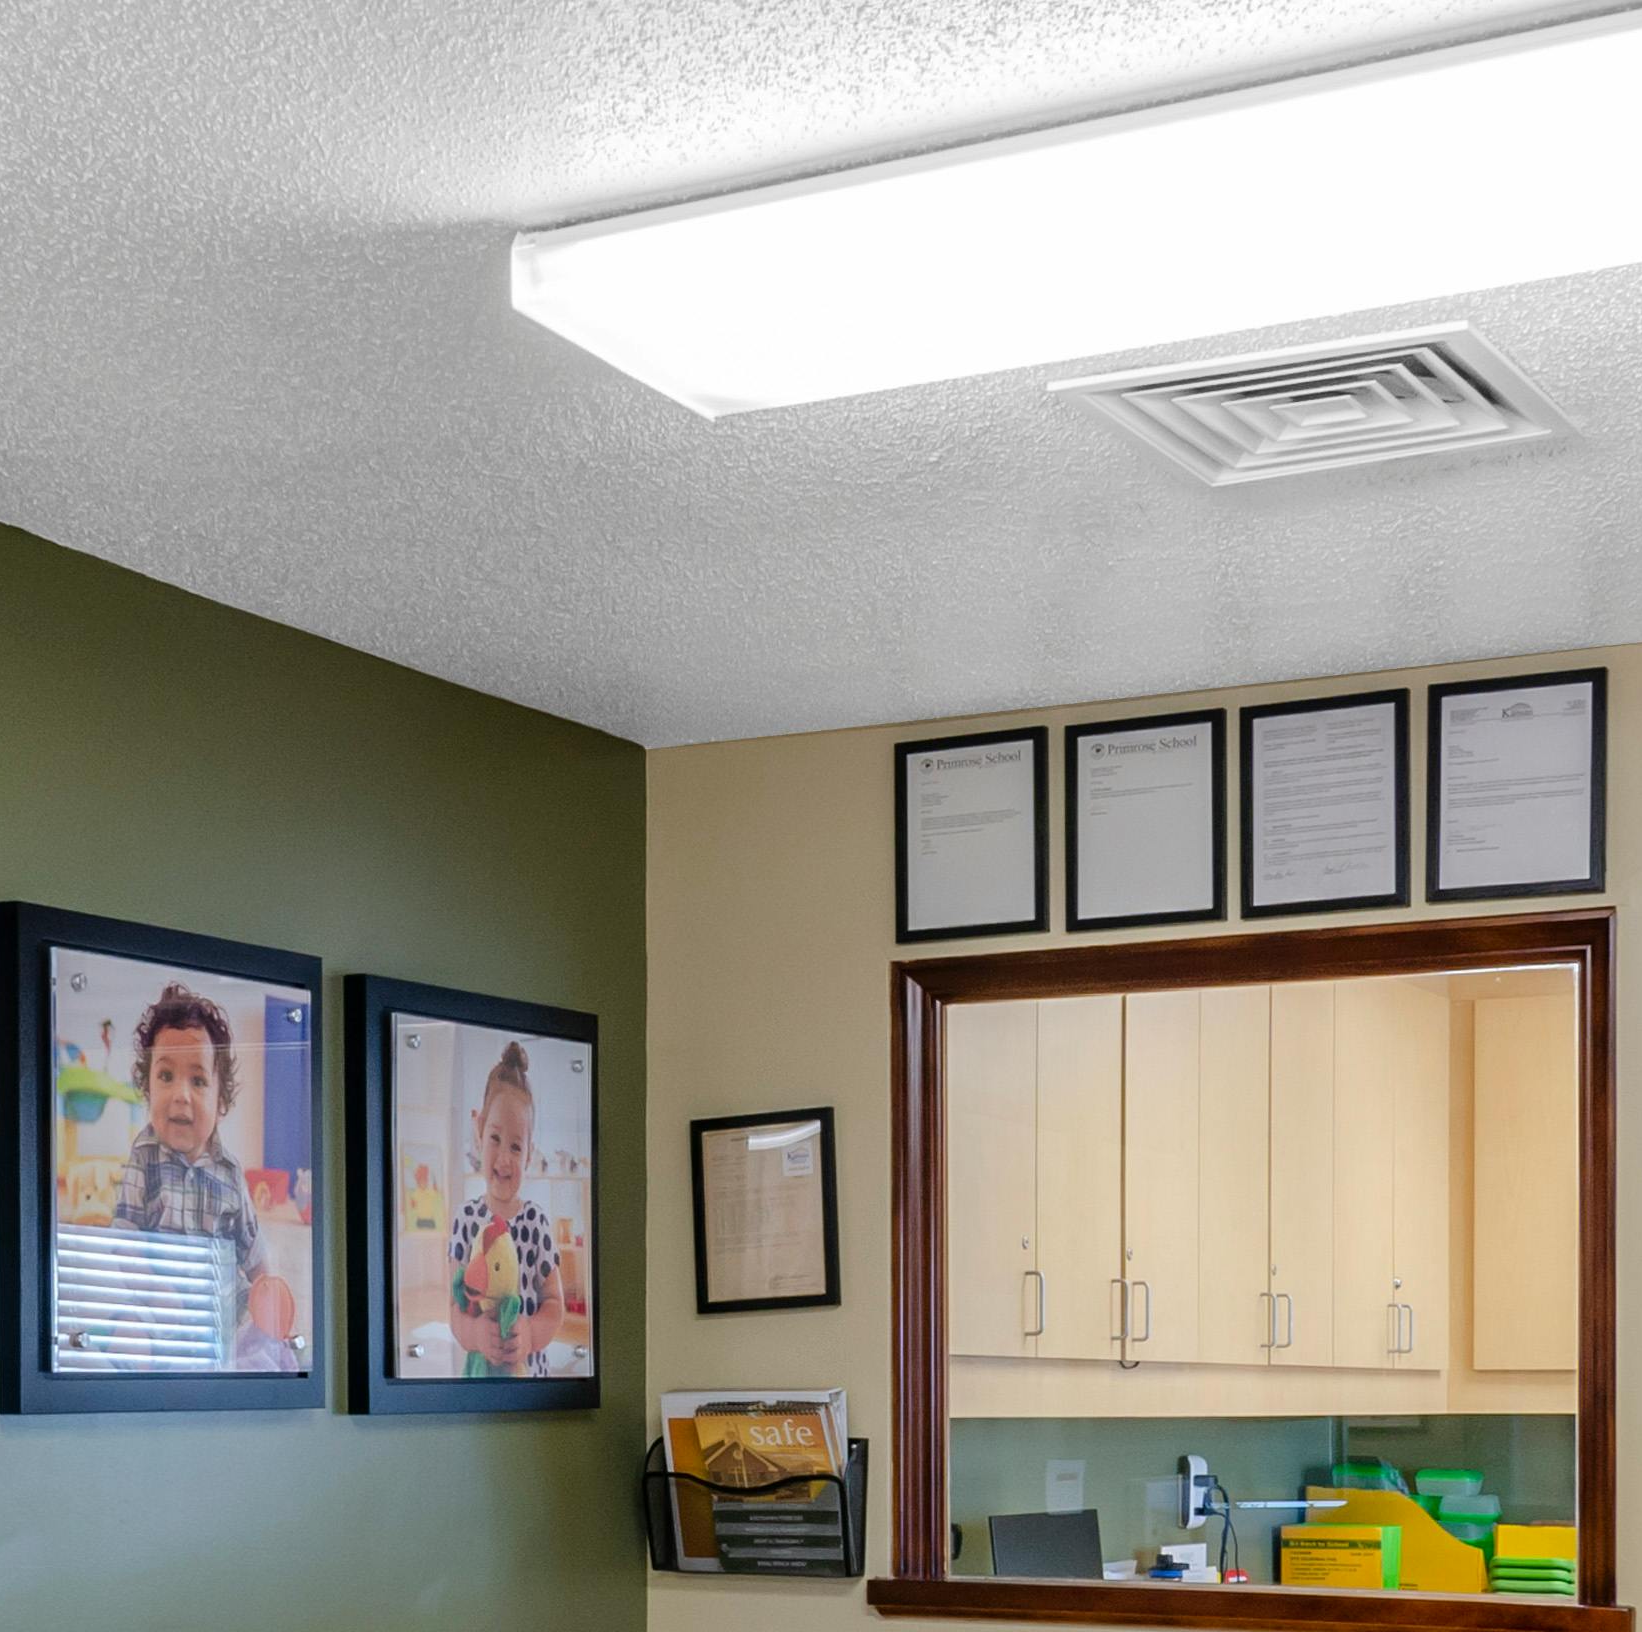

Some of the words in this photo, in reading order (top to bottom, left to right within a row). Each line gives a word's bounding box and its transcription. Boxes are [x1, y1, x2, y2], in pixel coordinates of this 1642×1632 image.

[1108, 742, 1155, 755] Primrose
[1159, 735, 1197, 749] School
[936, 758, 981, 771] Primrose
[985, 750, 1021, 764] School
[749, 1418, 815, 1447] safe
